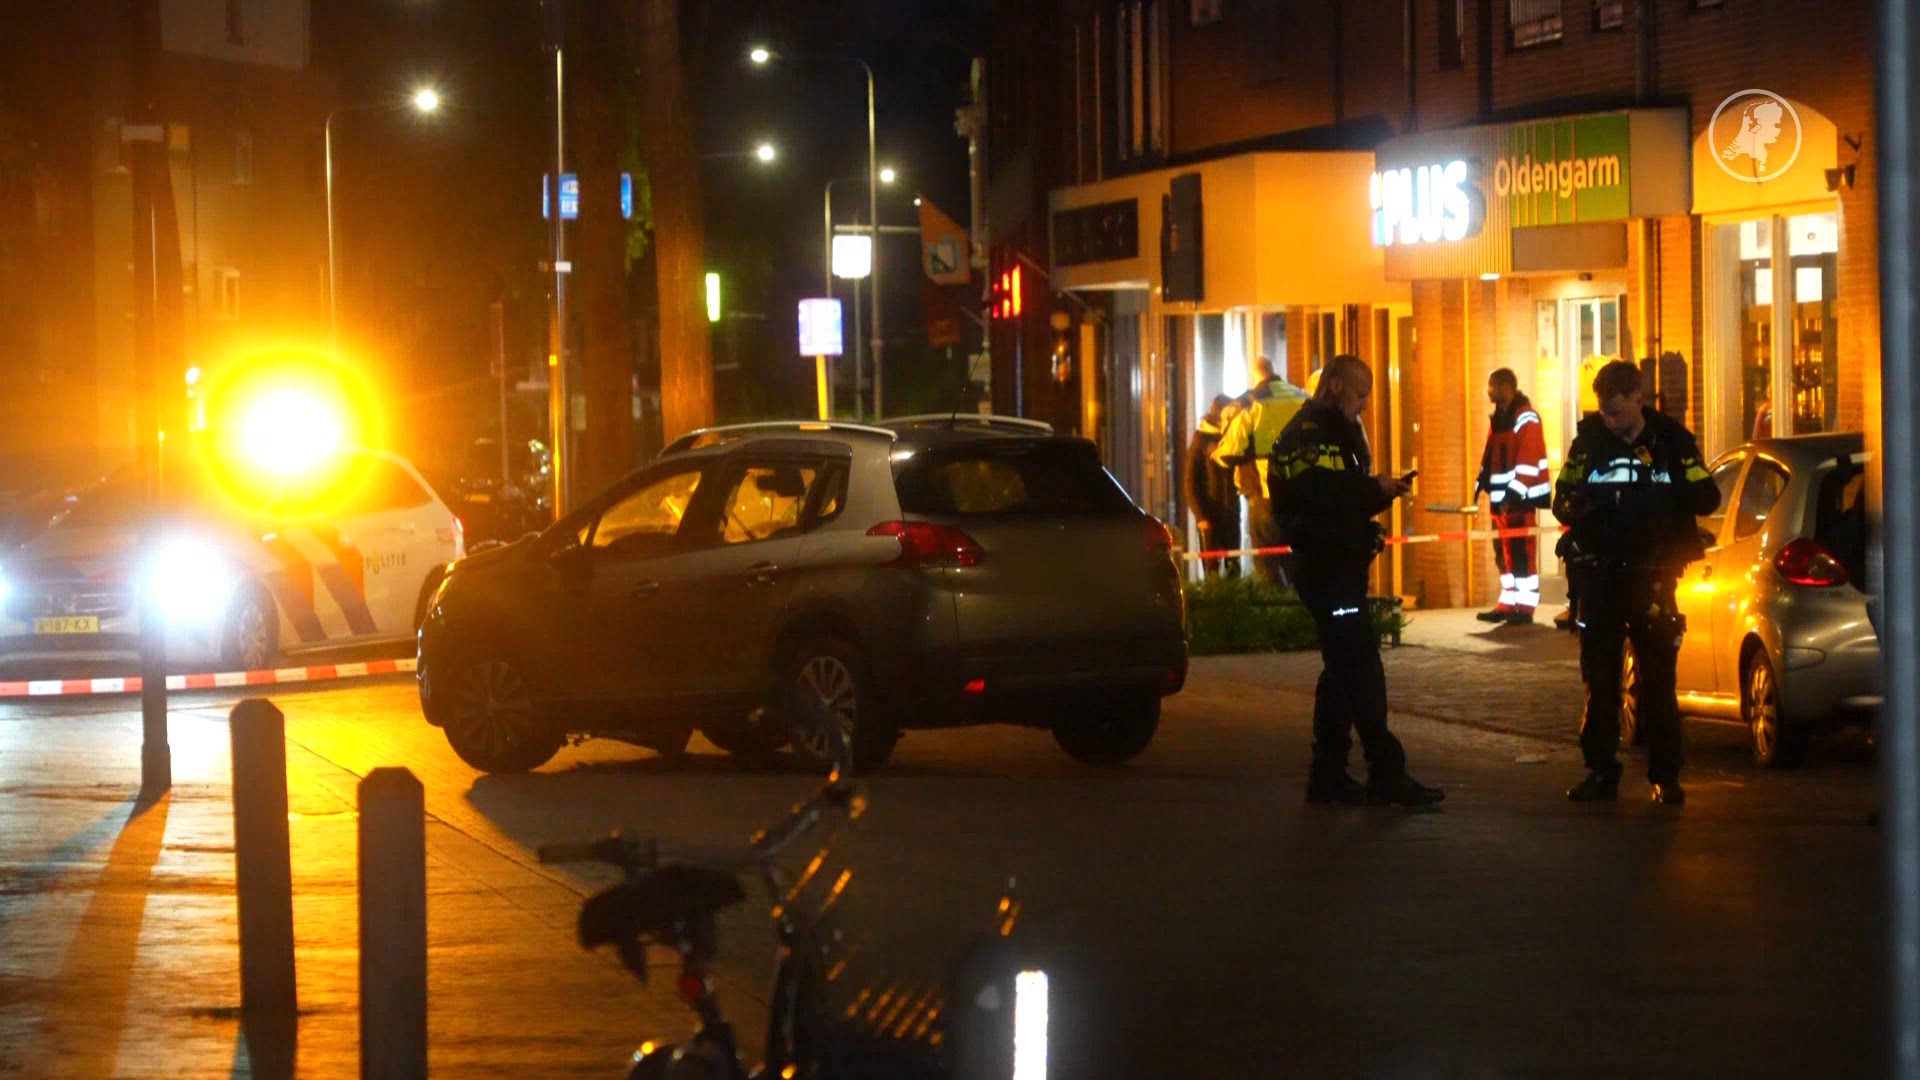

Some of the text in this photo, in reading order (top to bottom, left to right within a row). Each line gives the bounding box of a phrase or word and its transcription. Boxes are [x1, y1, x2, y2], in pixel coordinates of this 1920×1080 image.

[1382, 153, 1621, 246] PLUS Oldengarm
[366, 552, 407, 576] POLITIE
